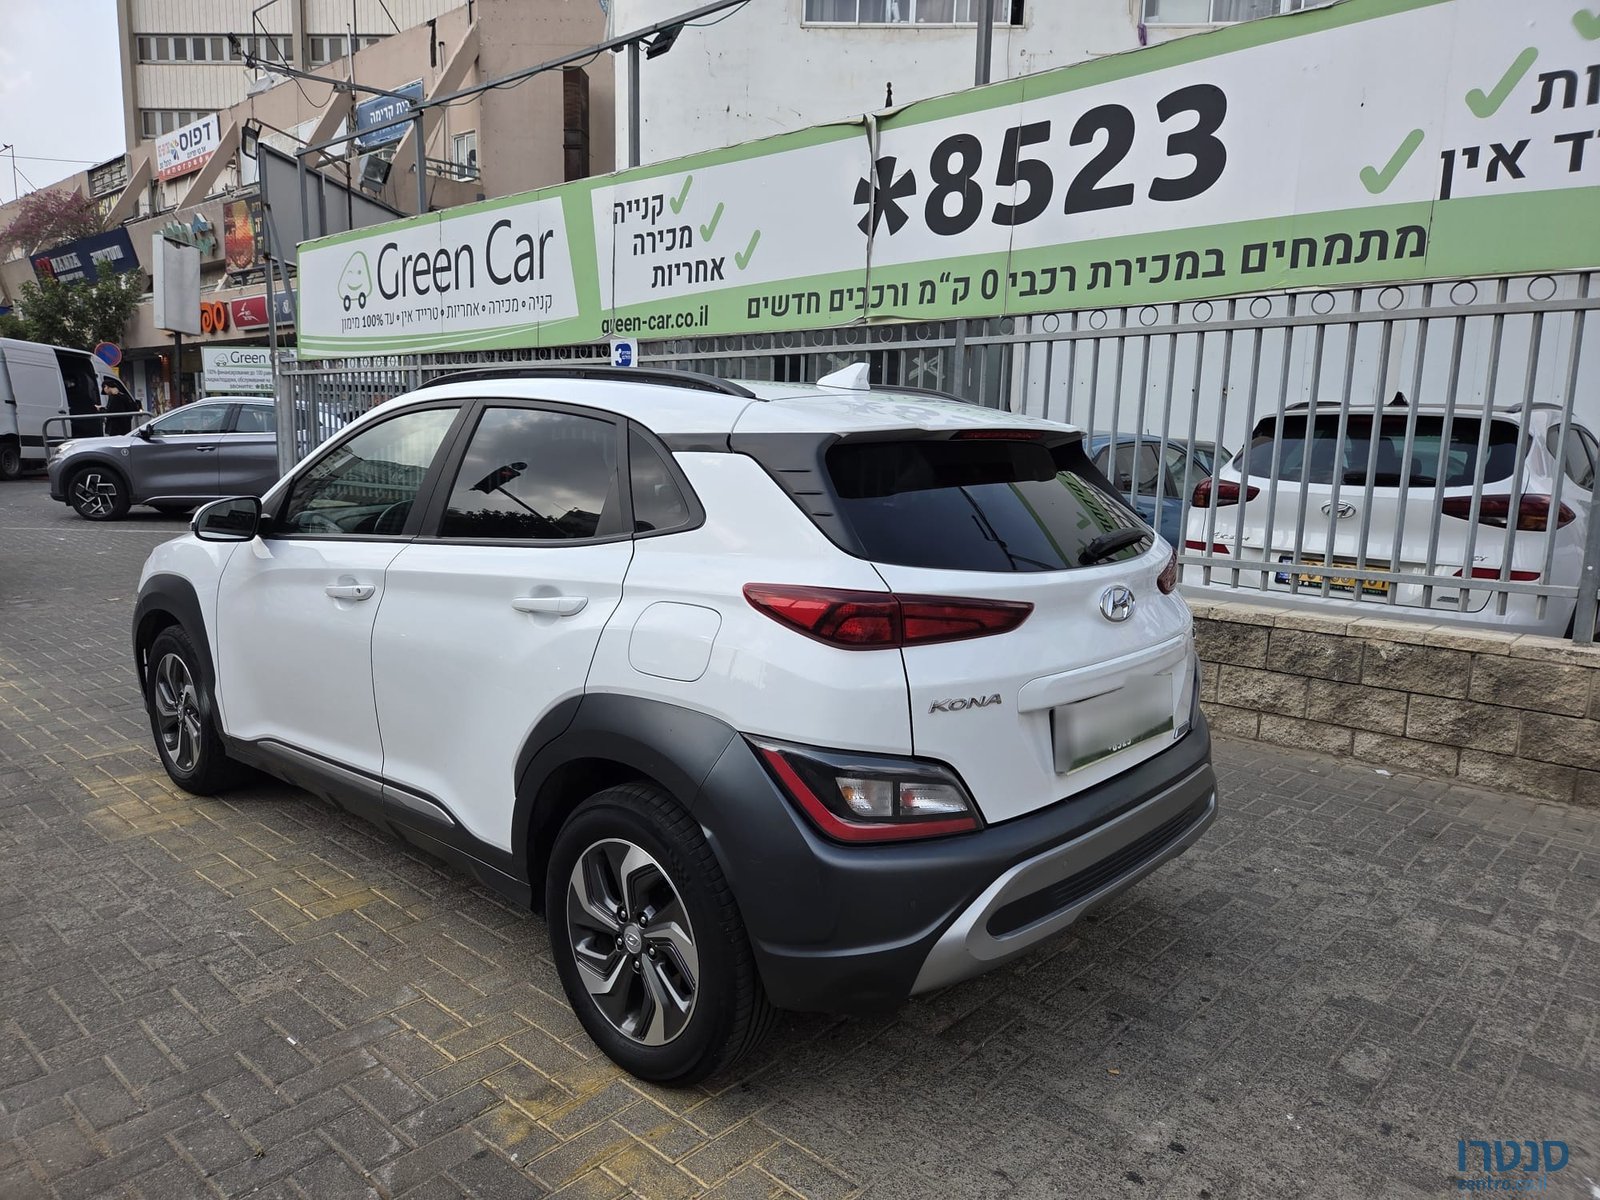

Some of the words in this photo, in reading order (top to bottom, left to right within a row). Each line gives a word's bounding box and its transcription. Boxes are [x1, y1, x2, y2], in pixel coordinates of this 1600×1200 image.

[369, 104, 395, 124] קדימה
[179, 122, 211, 152] דפוס
[1439, 138, 1532, 201] אין
[613, 193, 664, 225] קנייה
[633, 225, 693, 256] מכירה
[1240, 224, 1427, 275] מתמחים
[377, 242, 475, 301] Green
[485, 218, 554, 286] Car
[651, 256, 726, 289] אחריות
[1089, 247, 1226, 288] במכירת
[981, 268, 999, 299] 0
[1008, 262, 1077, 298] רכבי
[446, 301, 480, 319] אחריות
[488, 296, 520, 315] מכירה
[528, 293, 553, 317] קניה
[746, 289, 820, 320] חדשים
[828, 281, 910, 313] ורכבים
[341, 317, 360, 334] מימון
[362, 314, 384, 328] 100%
[384, 312, 395, 326] עד
[400, 309, 413, 327] אין
[415, 306, 440, 322] טרייד
[231, 351, 266, 363] Green
[928, 692, 1003, 714] KONA
